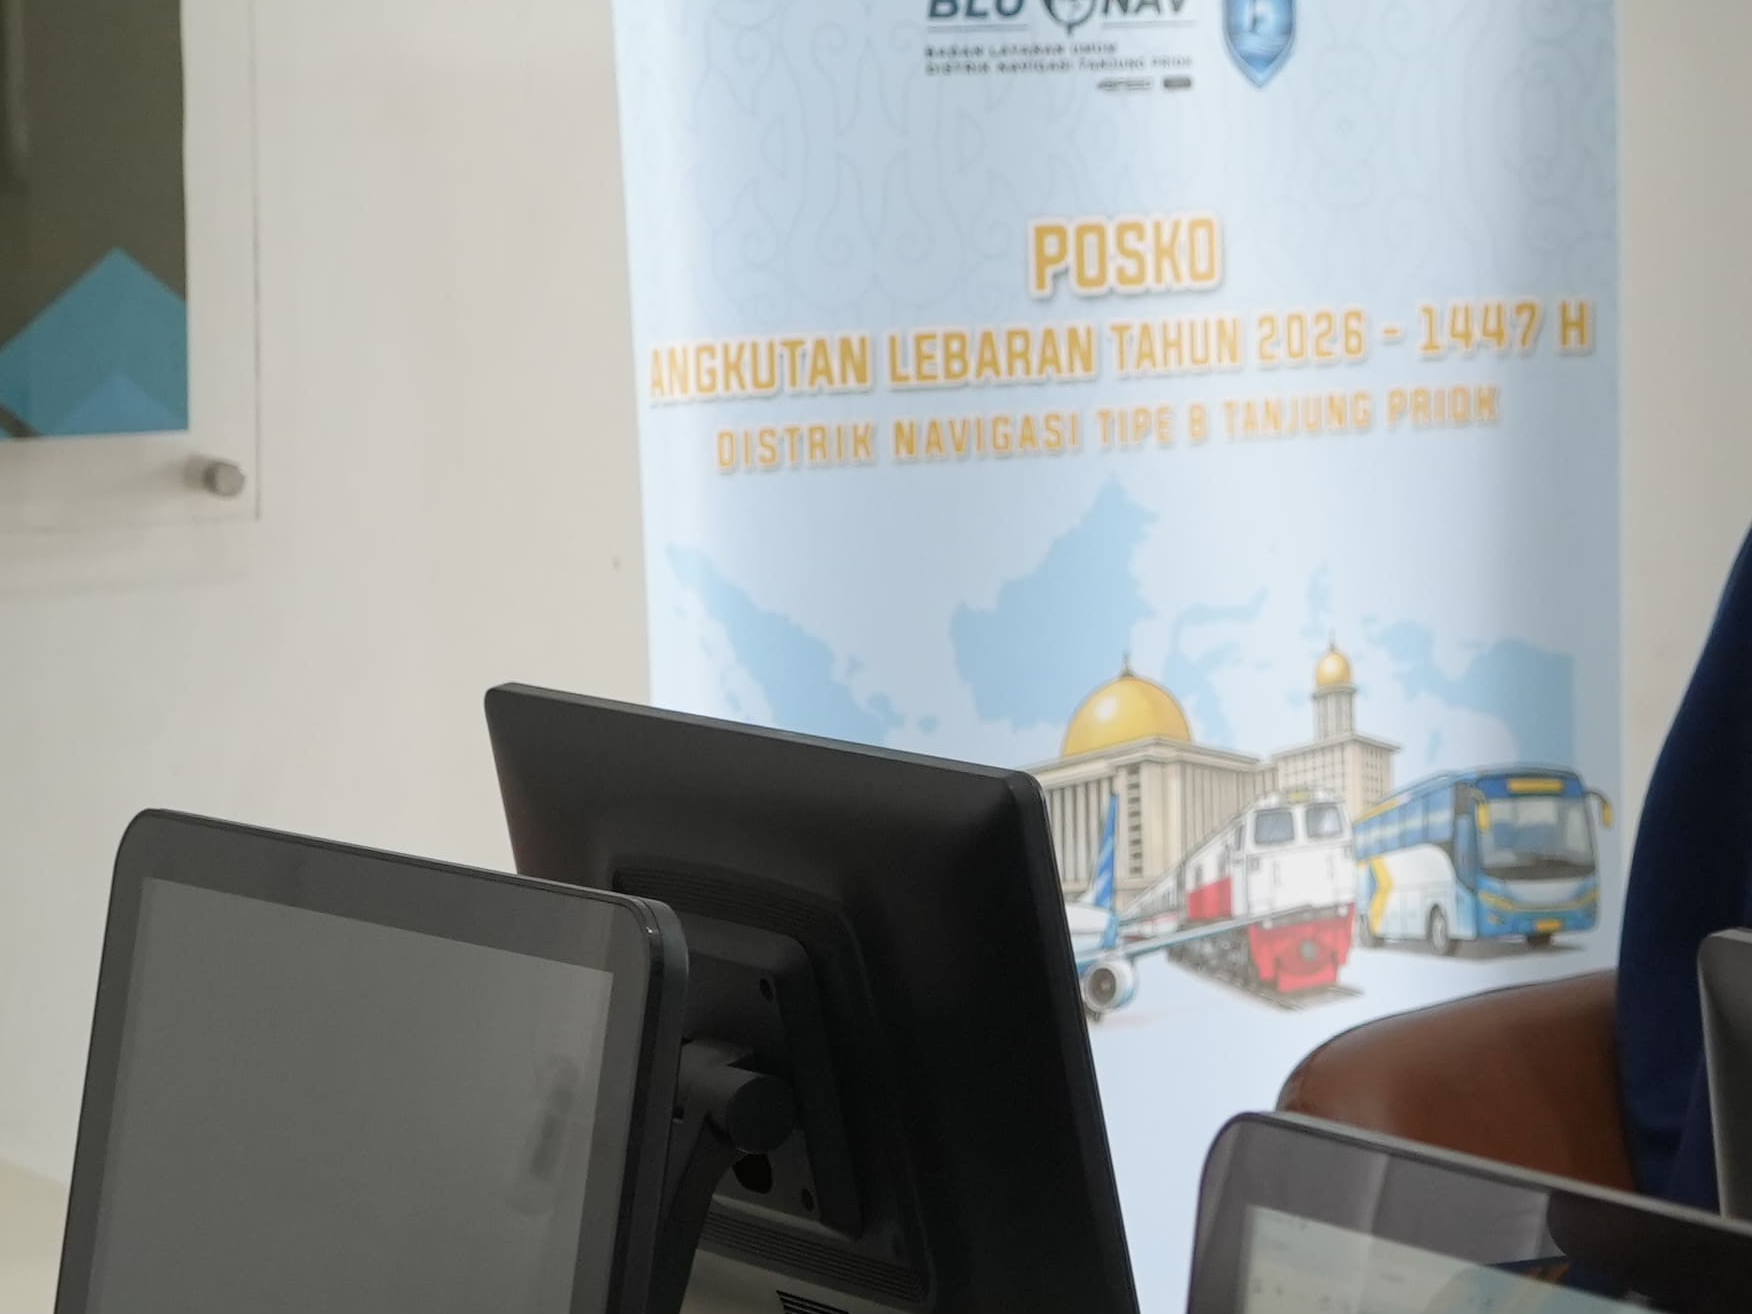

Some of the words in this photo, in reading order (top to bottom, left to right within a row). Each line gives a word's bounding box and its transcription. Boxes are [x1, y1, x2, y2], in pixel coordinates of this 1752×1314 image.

[1029, 214, 1223, 299] POSKO
[647, 332, 873, 403] ANGKUTAN
[884, 322, 1099, 389] LEBARAN
[1106, 314, 1244, 378] TAHUN
[1253, 306, 1369, 366] 2026
[1415, 299, 1544, 360] 1447
[1554, 295, 1597, 353] H
[714, 420, 876, 474] DISTRIK
[890, 410, 1082, 463] NAVIGASI
[1093, 405, 1175, 450] TIPE
[1184, 401, 1211, 444] B
[1221, 389, 1374, 440] TANJUNG
[1383, 383, 1503, 429] PRIOK
